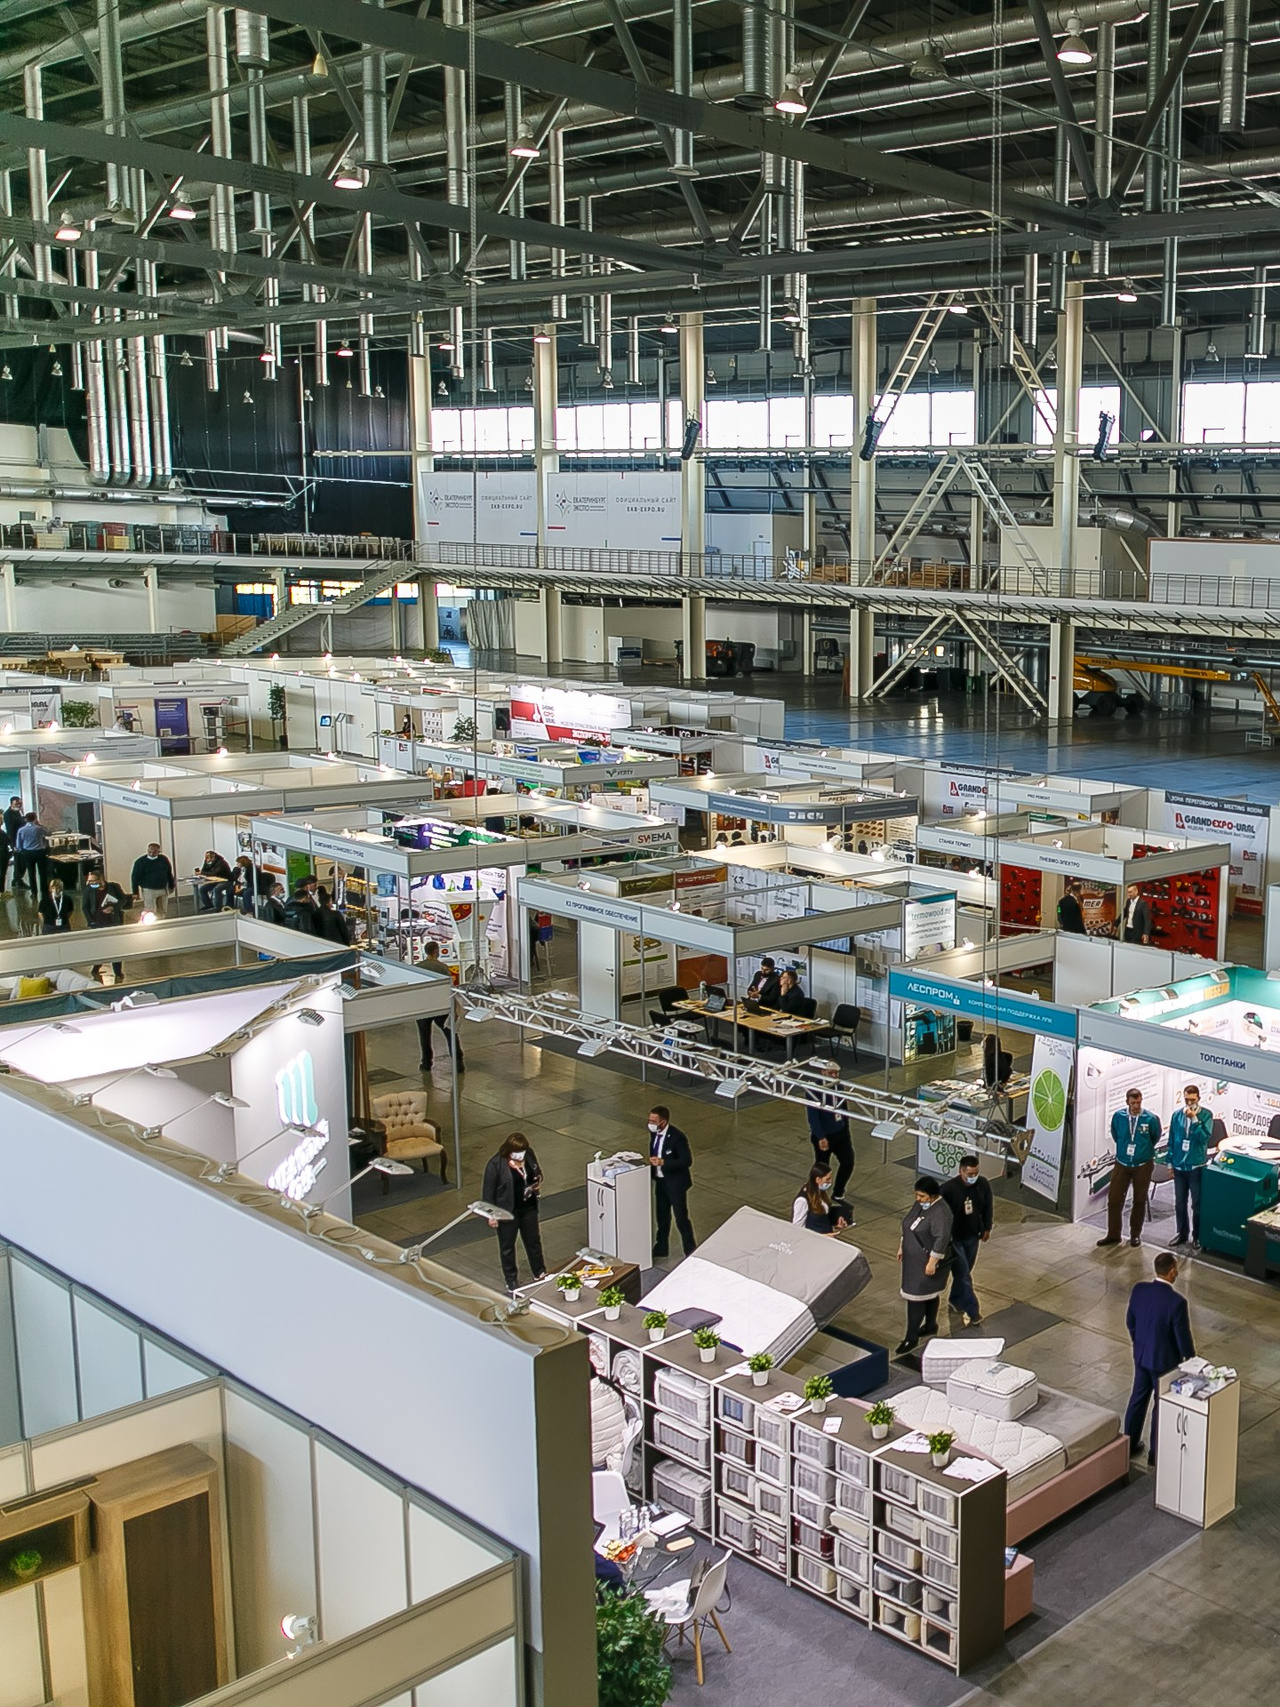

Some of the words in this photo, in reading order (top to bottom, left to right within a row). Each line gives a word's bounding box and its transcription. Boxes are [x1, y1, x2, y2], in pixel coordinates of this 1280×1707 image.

[604, 908, 639, 923] ОБЕСПЕЧЕНИЕ
[907, 982, 954, 1000] ЛЕСПРОМ
[1007, 1008, 1041, 1021] ПОДДЕРЖКА
[1199, 1052, 1247, 1071] ТОПСТАНКИ
[1232, 1108, 1272, 1129] ОБОРУДОВ
